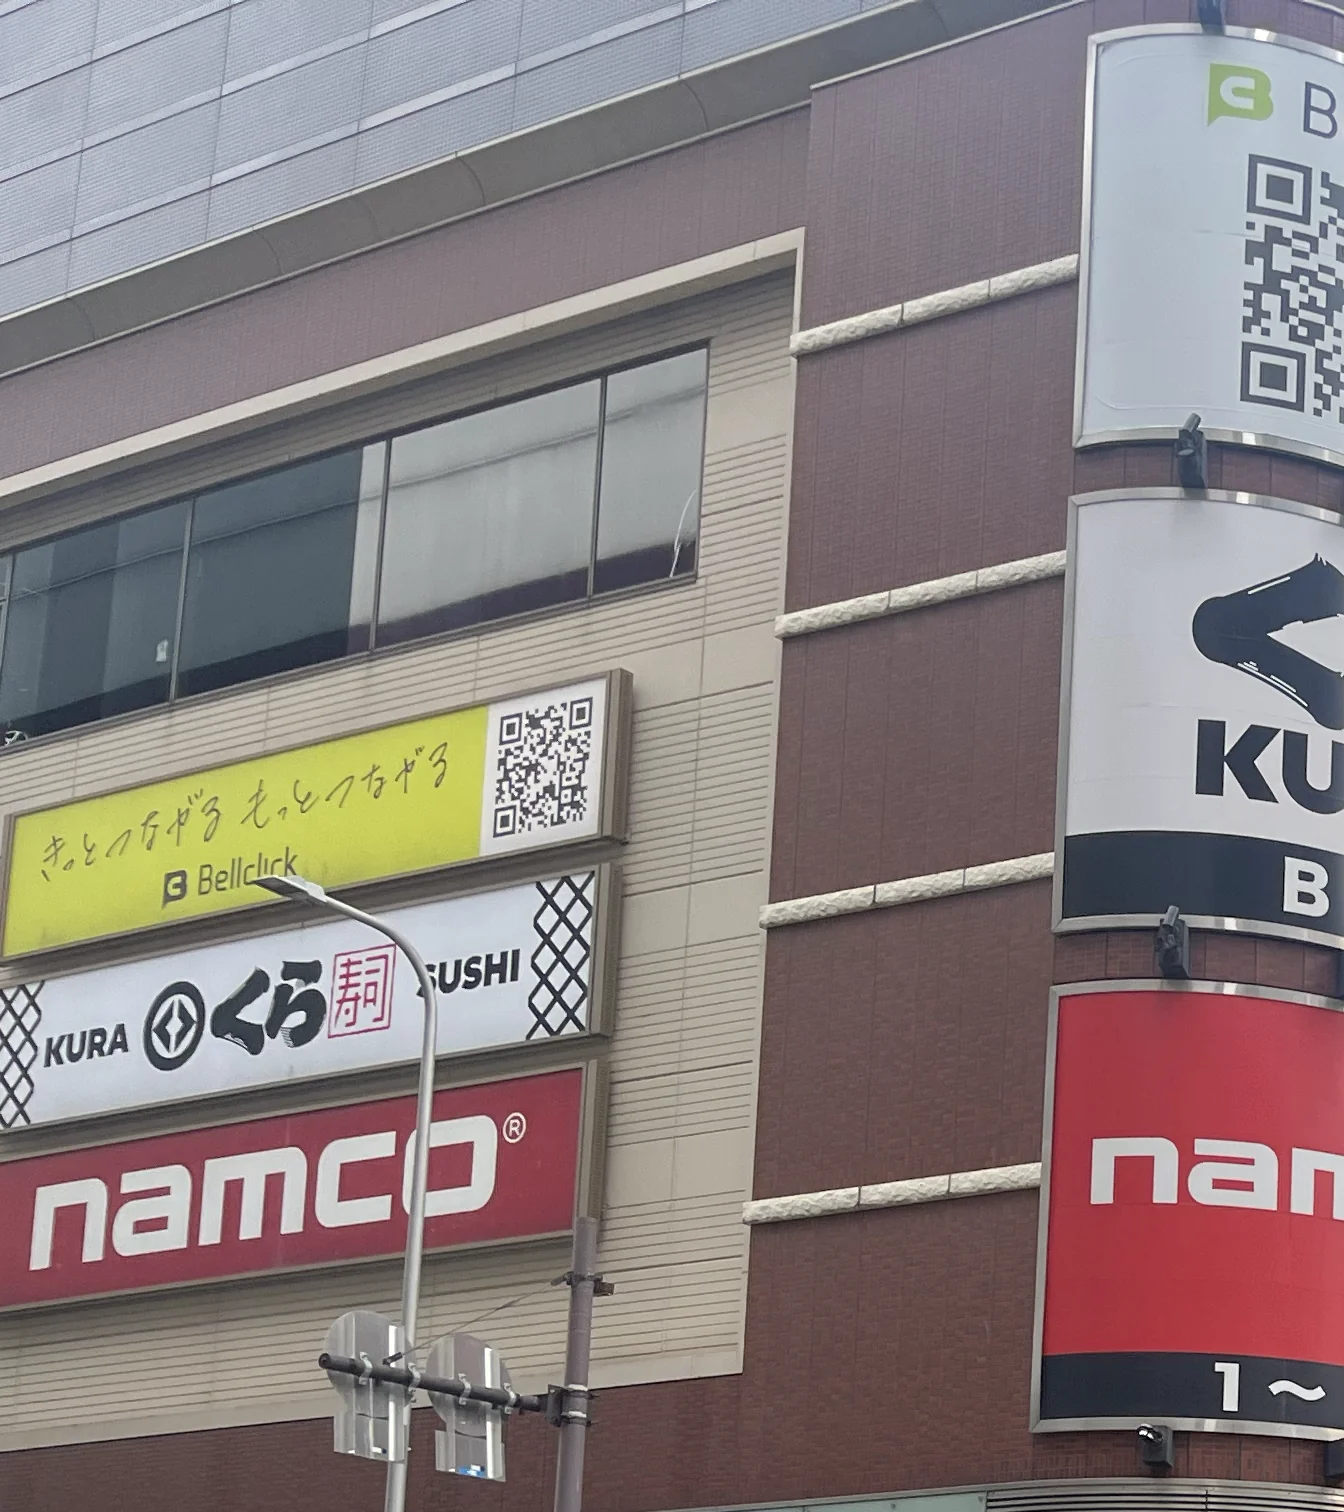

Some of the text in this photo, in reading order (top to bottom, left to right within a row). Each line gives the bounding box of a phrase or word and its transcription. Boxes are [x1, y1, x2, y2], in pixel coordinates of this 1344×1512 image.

[43, 1022, 130, 1068] KURA
[210, 960, 327, 1057] くら
[28, 1113, 500, 1272] namco
